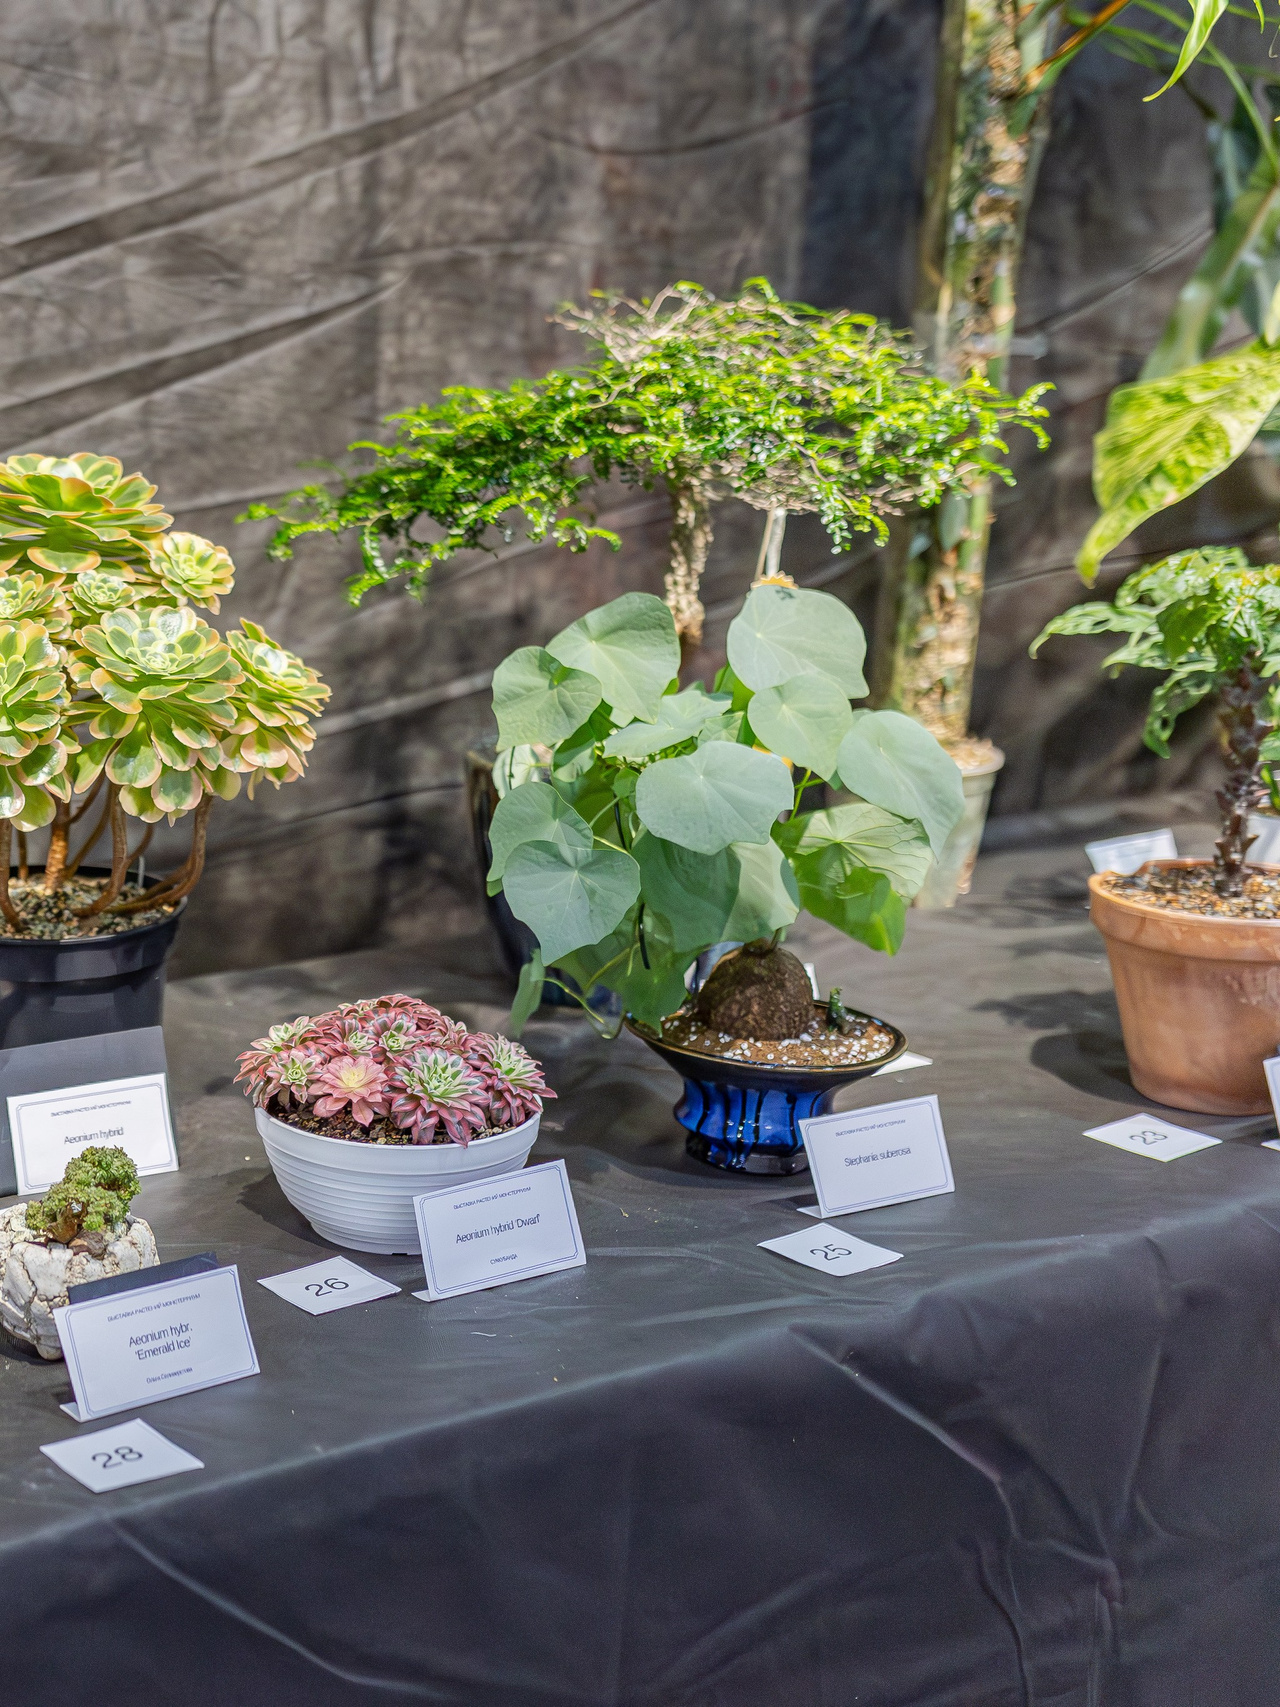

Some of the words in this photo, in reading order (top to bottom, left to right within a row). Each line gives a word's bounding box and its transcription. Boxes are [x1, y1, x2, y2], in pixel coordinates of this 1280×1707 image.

[64, 1132, 98, 1145] Aeonium
[99, 1127, 124, 1140] hybrid
[1129, 1130, 1168, 1145] 23
[844, 1151, 878, 1167] Stephania
[880, 1147, 911, 1160] suberosa
[456, 1229, 489, 1244] Aeonium
[490, 1220, 514, 1236] hybrid
[810, 1243, 852, 1261] 25
[305, 1277, 349, 1297] 26
[129, 1330, 169, 1347] Aeonium
[169, 1322, 193, 1337] hybr.
[91, 1446, 143, 1469] 28
